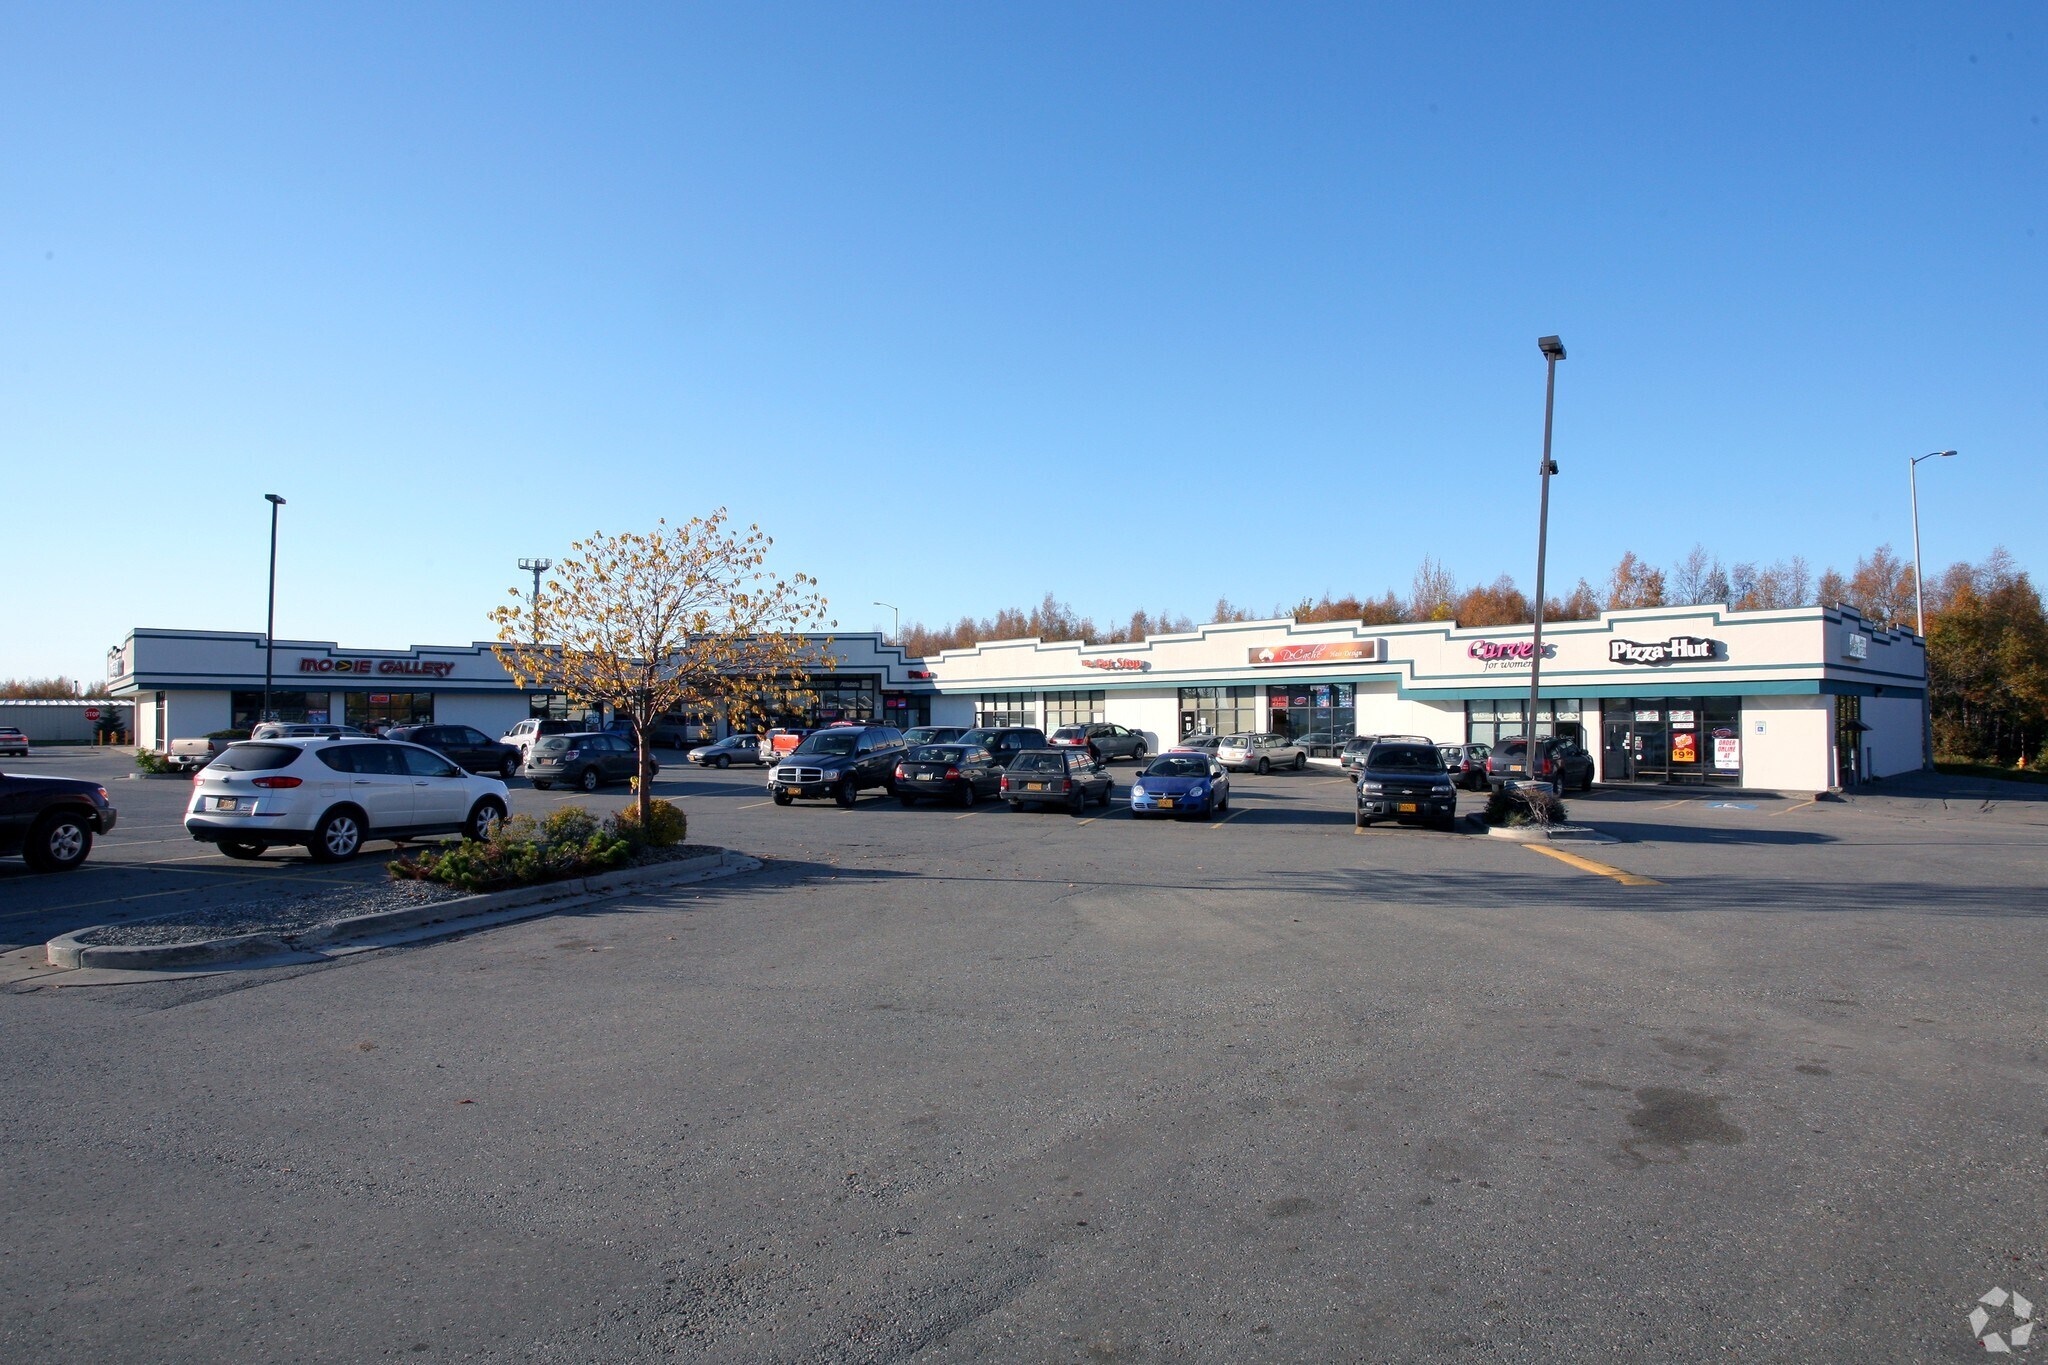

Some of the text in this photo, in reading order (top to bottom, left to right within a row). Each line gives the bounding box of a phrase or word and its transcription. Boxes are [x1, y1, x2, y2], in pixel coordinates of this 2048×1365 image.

[1344, 650, 1363, 658] Design
[1611, 638, 1710, 661] Pizza Hut
[378, 660, 455, 678] GALLERY
[1096, 658, 1114, 669] Pet
[1117, 657, 1143, 671] Stop
[1483, 660, 1498, 673] for
